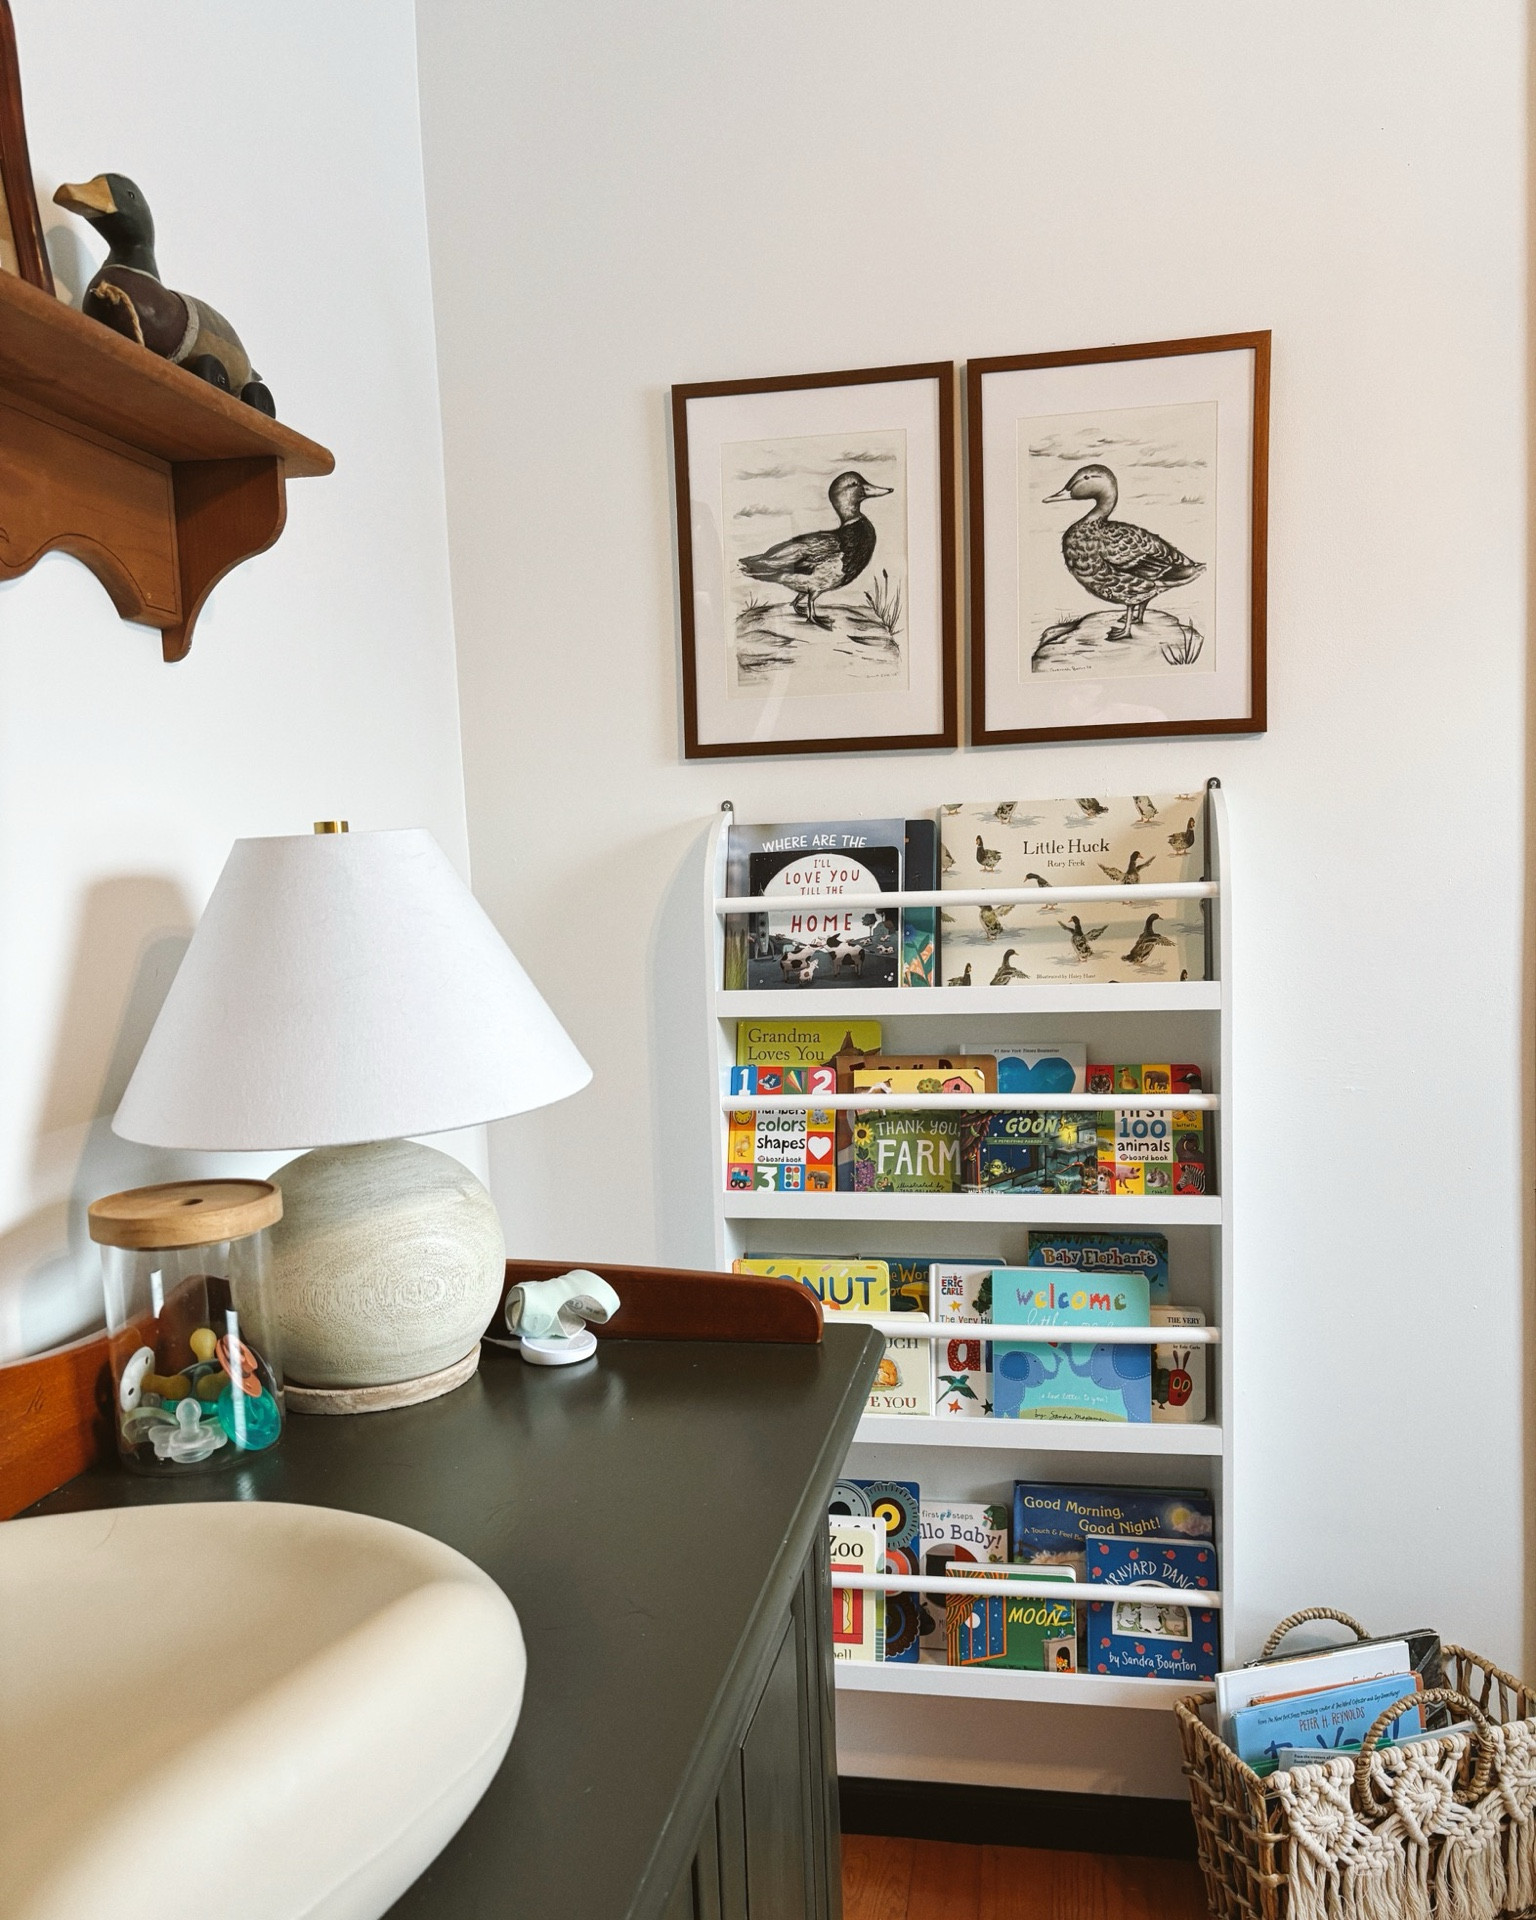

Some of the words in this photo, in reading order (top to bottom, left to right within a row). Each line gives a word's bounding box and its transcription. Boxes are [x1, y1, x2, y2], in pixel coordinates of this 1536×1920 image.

[762, 835, 807, 852] WHERE
[812, 834, 837, 847] ARE
[842, 834, 867, 848] THE
[1023, 840, 1064, 855] Little
[1068, 838, 1110, 853] Huck
[813, 859, 831, 869] I'LL
[1047, 859, 1066, 868] Rory
[785, 871, 821, 885] LOVE
[830, 869, 860, 882] YOU
[800, 887, 821, 896] TILL
[826, 885, 844, 895] THE
[791, 913, 853, 933] HOME
[748, 1028, 821, 1044] Grandma
[747, 1046, 790, 1061] Loves
[797, 1046, 825, 1061] You
[738, 1068, 751, 1095] 1
[812, 1069, 832, 1095] 2
[757, 1117, 806, 1132] colors
[876, 1120, 925, 1137] THANK
[929, 1119, 961, 1137] YOU,
[1005, 1117, 1058, 1134] GOON
[1120, 1118, 1167, 1138] 100
[757, 1135, 806, 1154] shapes
[1117, 1140, 1171, 1152] animals
[877, 1140, 962, 1176] FARM
[757, 1166, 778, 1191] 3
[1042, 1249, 1080, 1265] Baby
[1083, 1248, 1157, 1265] Elephant's
[941, 1287, 963, 1295] CARLE
[1016, 1282, 1127, 1311] welcome
[940, 1315, 955, 1323] The
[883, 1397, 917, 1408] YOU
[922, 1509, 939, 1518] first
[952, 1512, 974, 1521] steps
[1024, 1496, 1060, 1510] Good
[1066, 1501, 1125, 1519] Morning,
[1059, 1530, 1073, 1539] Feel
[1079, 1519, 1115, 1534] Good
[1119, 1517, 1161, 1535] Night!
[950, 1525, 1002, 1549] Baby!
[1008, 1607, 1063, 1626] MOON
[1109, 1652, 1120, 1667] by
[1122, 1652, 1154, 1667] Sandra
[1157, 1654, 1197, 1674] Boynton
[1299, 1718, 1320, 1732] PETER
[1322, 1715, 1330, 1729] H.
[1331, 1706, 1365, 1726] REYNOLDS
